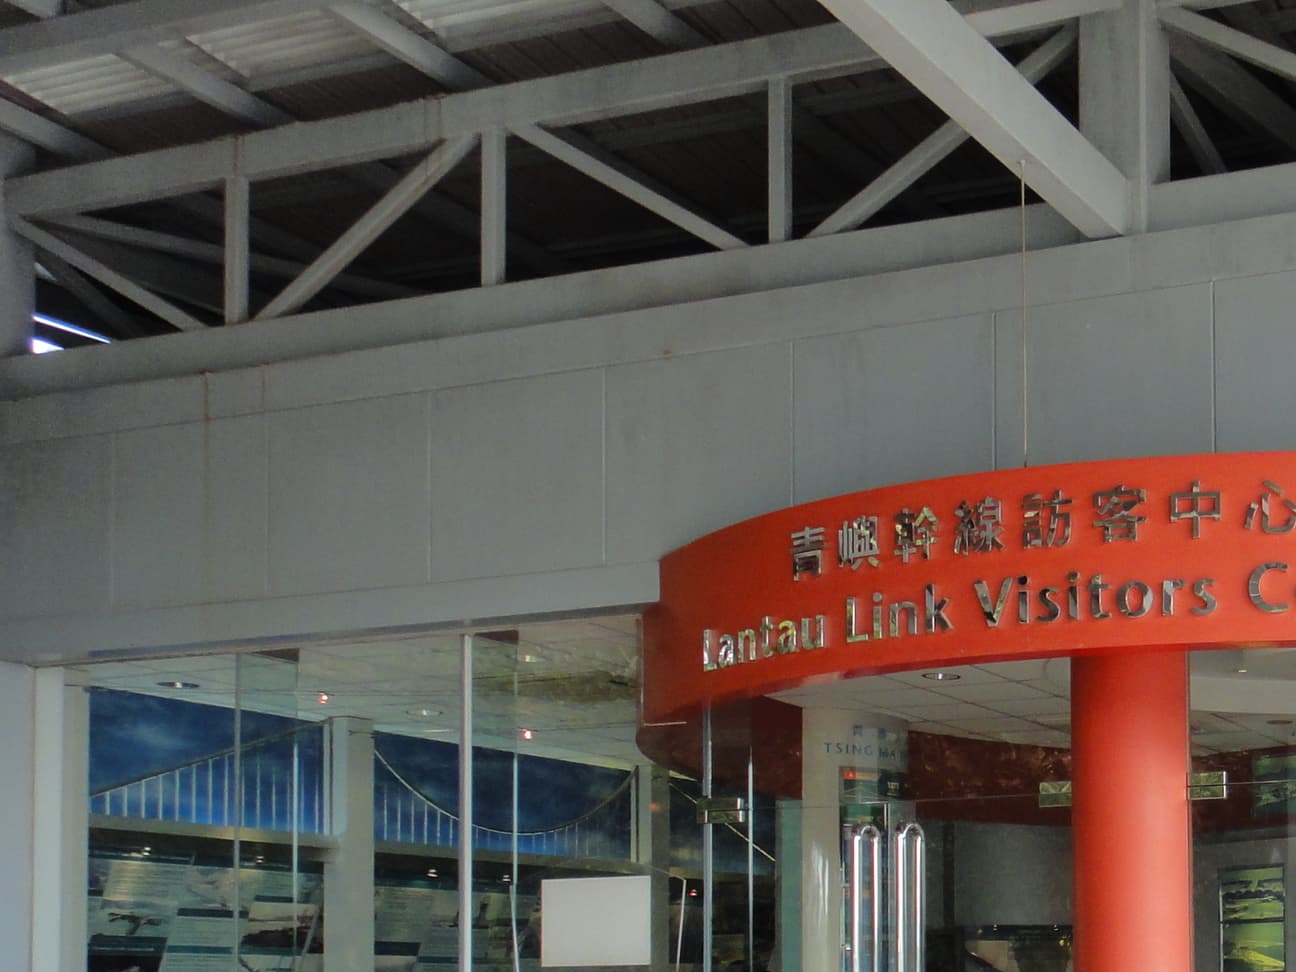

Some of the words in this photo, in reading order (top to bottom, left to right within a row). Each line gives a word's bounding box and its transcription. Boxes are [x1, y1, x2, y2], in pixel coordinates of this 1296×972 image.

[703, 615, 826, 672] Lantau
[845, 583, 953, 643] Link
[973, 570, 1218, 628] Visitors
[824, 742, 873, 756] TSING
